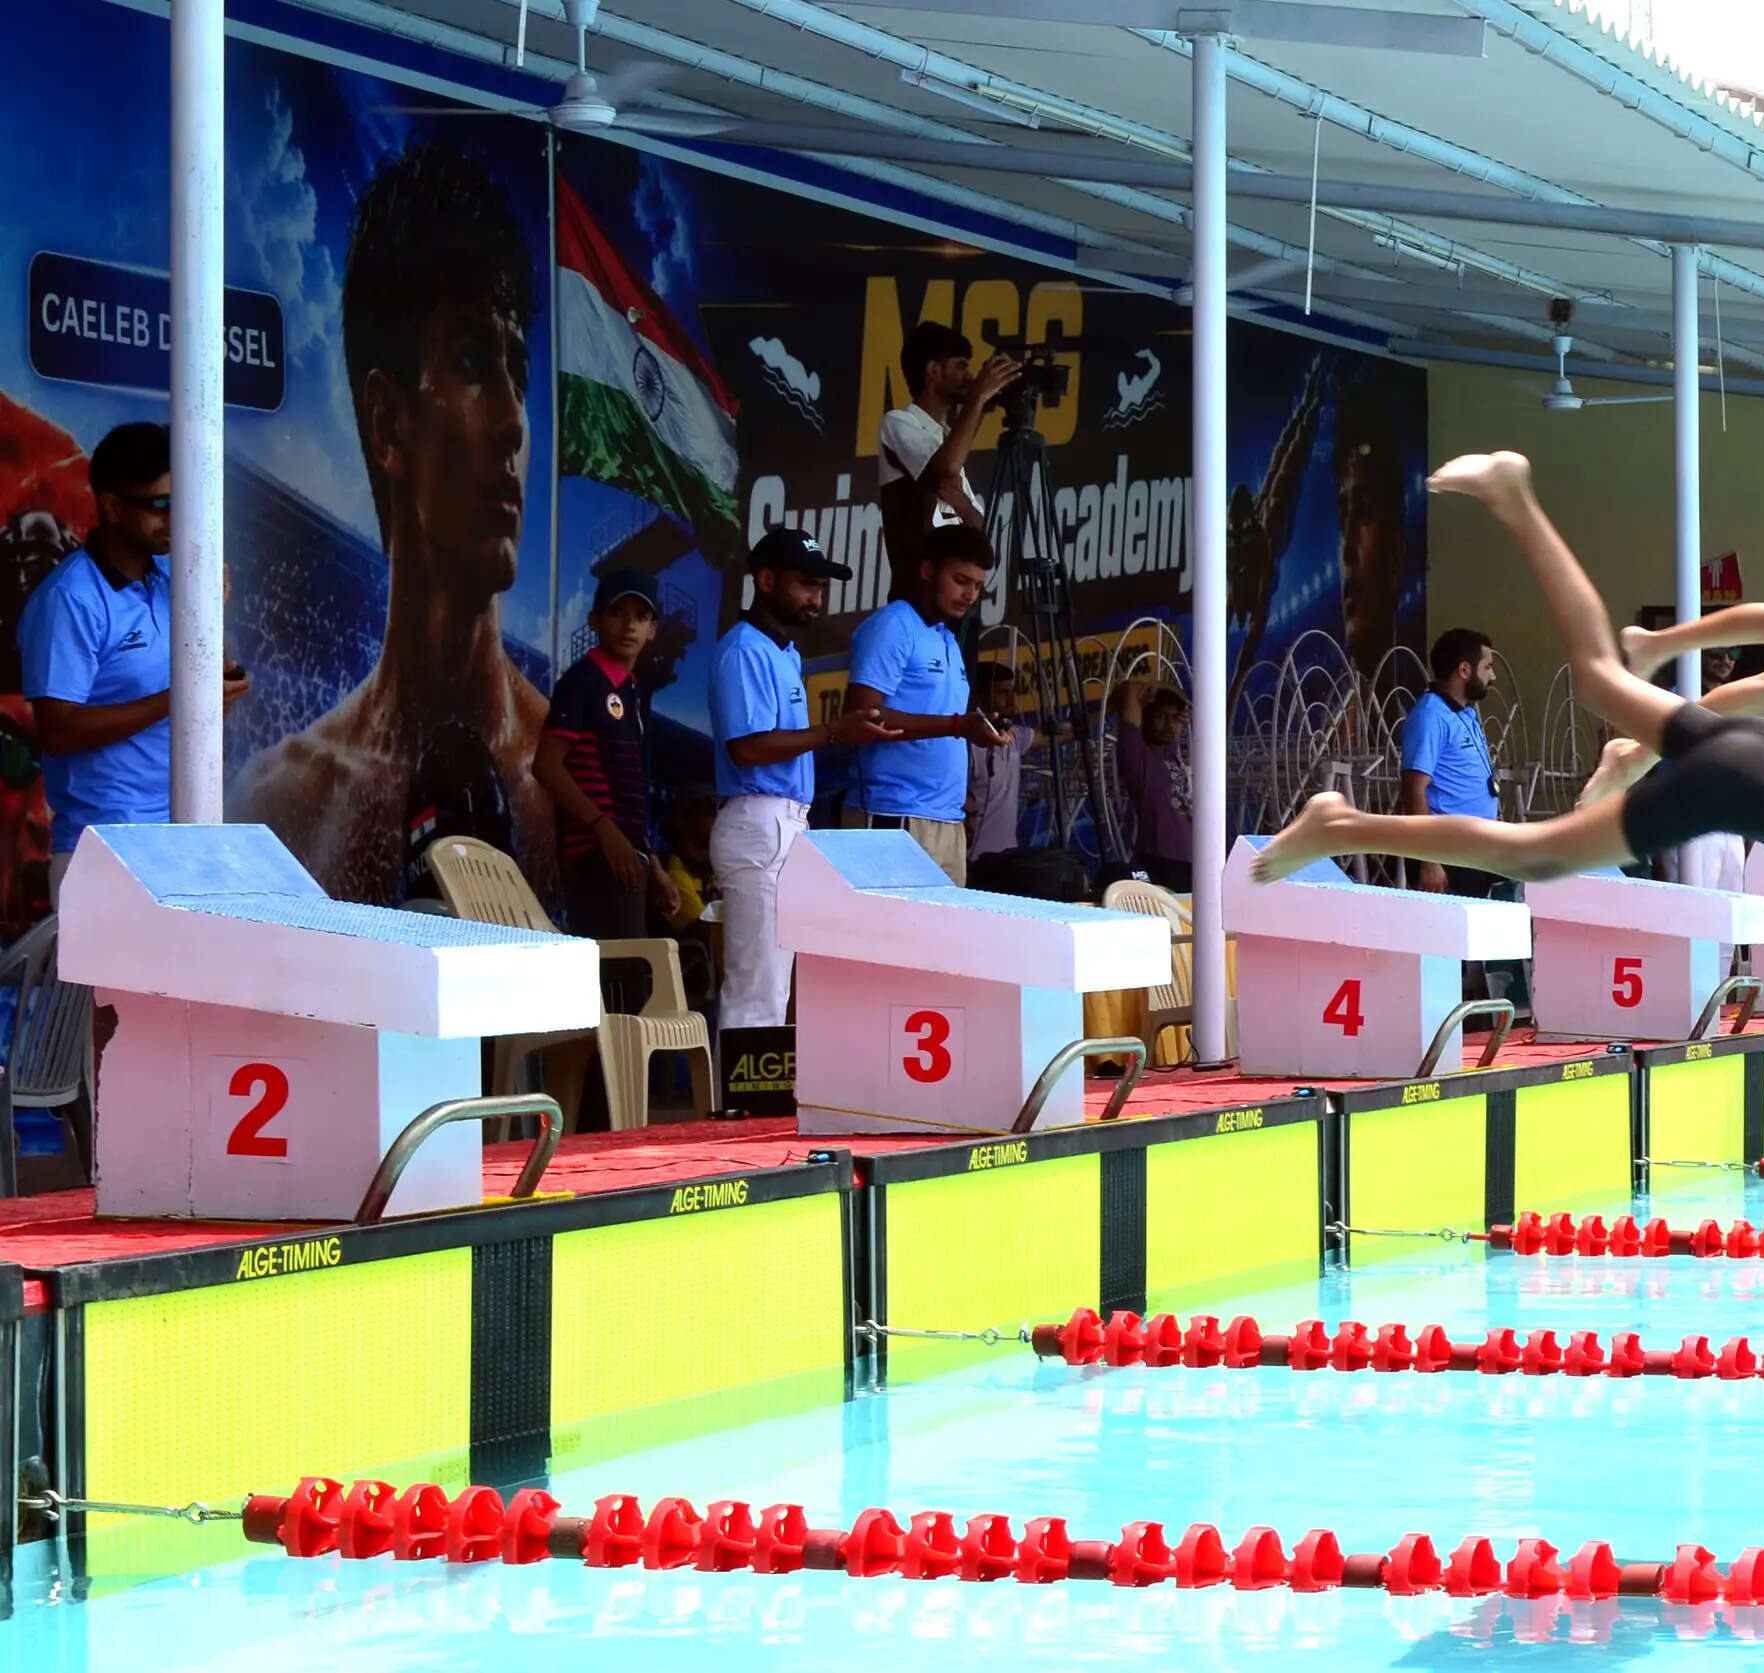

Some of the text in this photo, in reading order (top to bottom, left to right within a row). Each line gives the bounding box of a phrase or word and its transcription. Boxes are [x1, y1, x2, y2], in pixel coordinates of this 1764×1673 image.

[42, 293, 276, 368] CAELEB DSEL
[856, 276, 1083, 457] MSG
[741, 474, 1014, 627] Swimg
[1323, 979, 1364, 1037] 4
[1612, 957, 1644, 1007] 5
[903, 1009, 951, 1083] 3
[227, 1063, 289, 1157] 2
[1216, 1109, 1263, 1133] ALGE-TIMING
[968, 1141, 1028, 1170] ALGE-TIMING
[670, 1179, 749, 1213] ALGE-TIMING
[237, 1237, 342, 1280] ALGE-TIMING
